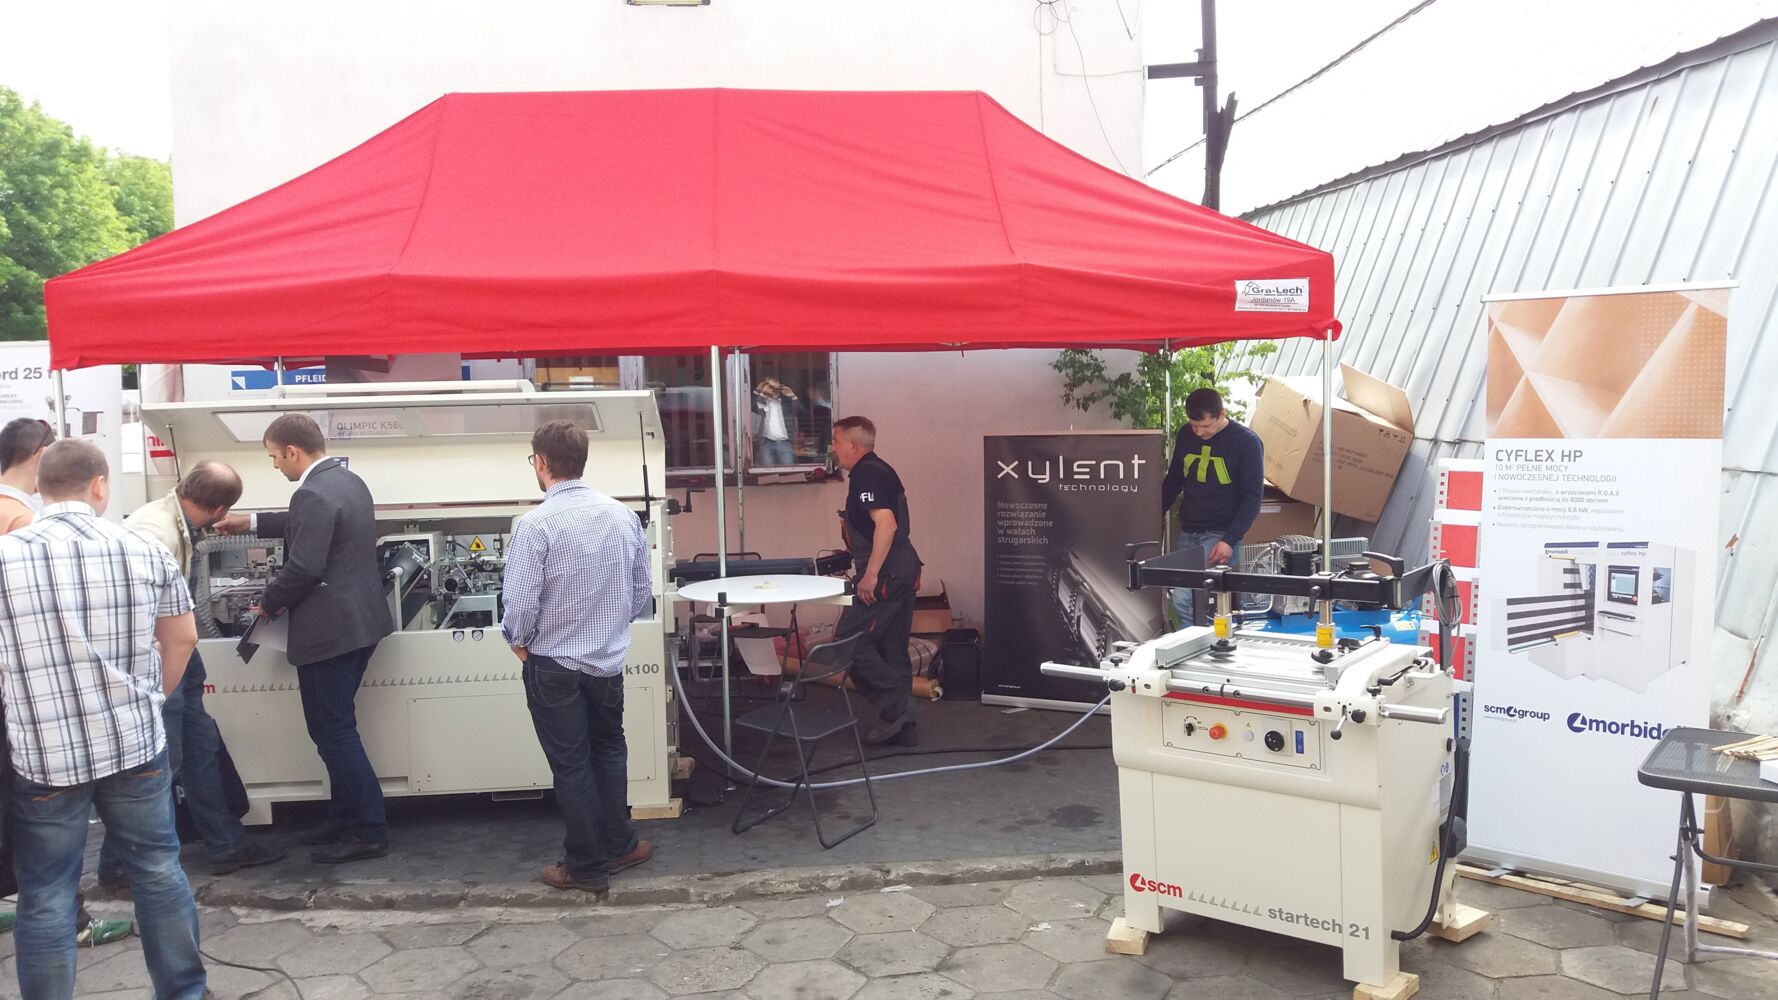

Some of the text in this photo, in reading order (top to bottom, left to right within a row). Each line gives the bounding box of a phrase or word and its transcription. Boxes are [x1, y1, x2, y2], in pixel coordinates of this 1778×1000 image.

[1251, 286, 1303, 294] Gra-Lech
[23, 367, 43, 380] 25
[336, 421, 377, 431] OLIMPIC
[1495, 449, 1584, 463] CYFLEX HP
[997, 454, 1147, 484] xylent
[1546, 464, 1569, 473] MOCY
[1499, 473, 1559, 482] NOWOCZESNEJ
[1562, 474, 1617, 483] TECHNOLOGII
[1059, 483, 1139, 493] technology
[997, 500, 1048, 509] Nowoczesne
[997, 510, 1047, 519] rozwiązanie
[997, 519, 1054, 528] wprowadzone
[997, 535, 1049, 546] strugarskich
[1483, 704, 1507, 715] scm
[1517, 708, 1551, 721] group
[1147, 879, 1183, 899] scm
[1268, 907, 1370, 940] startech 21
